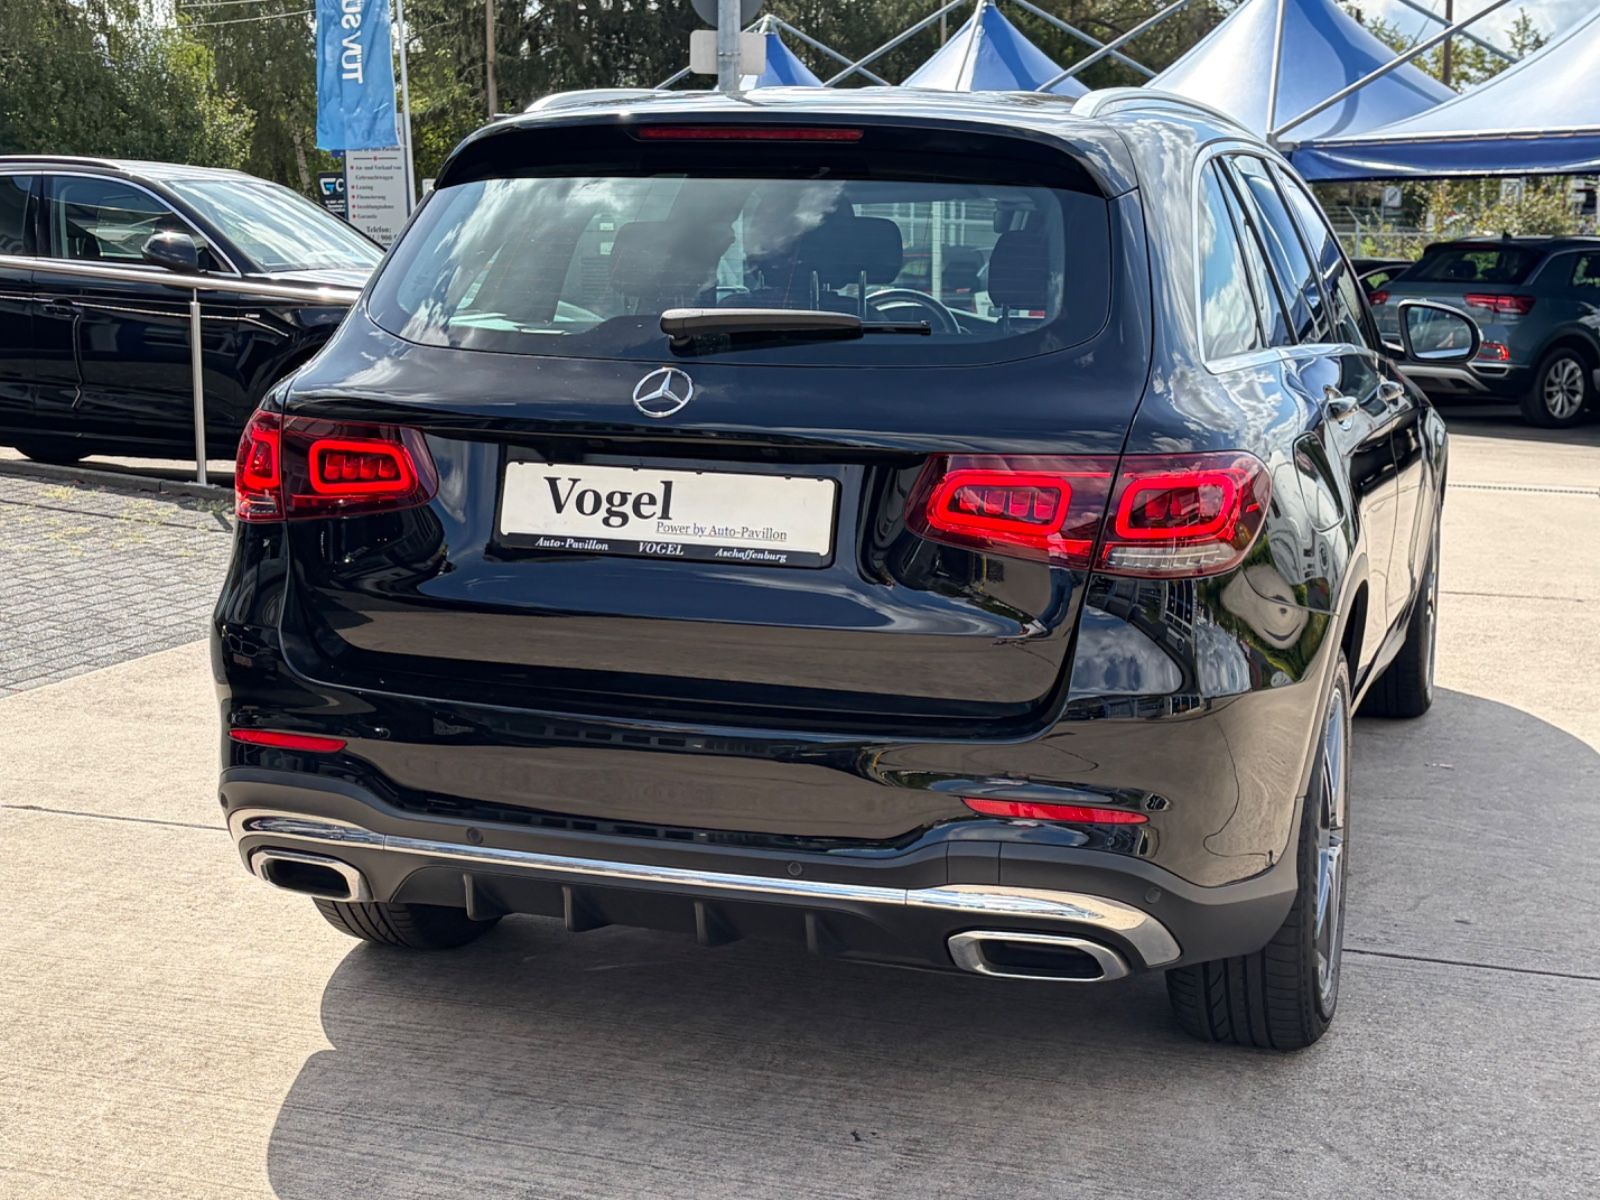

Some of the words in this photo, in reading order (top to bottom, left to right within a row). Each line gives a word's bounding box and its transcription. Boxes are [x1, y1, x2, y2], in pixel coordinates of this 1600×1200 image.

[543, 476, 674, 528] Vogel
[656, 521, 692, 535] Power
[692, 523, 707, 538] by
[708, 525, 788, 541] Auto-Pavillon
[638, 542, 685, 557] VOGEL
[714, 548, 787, 564] Aschaffenburg
